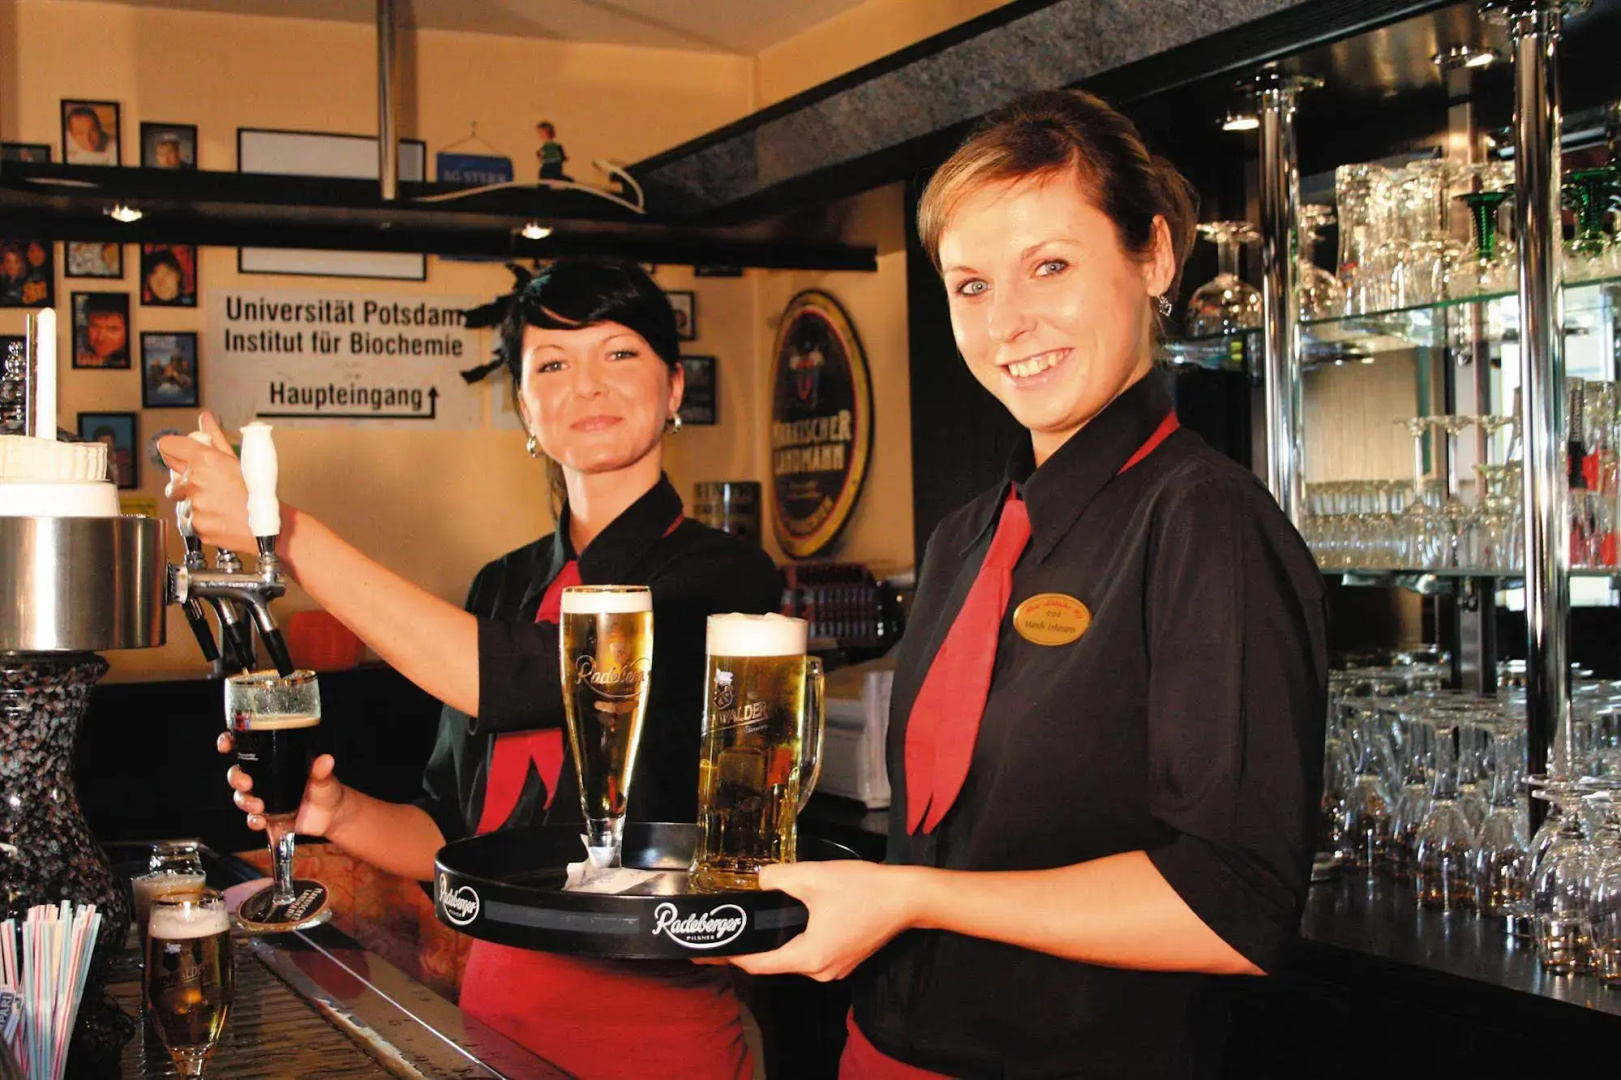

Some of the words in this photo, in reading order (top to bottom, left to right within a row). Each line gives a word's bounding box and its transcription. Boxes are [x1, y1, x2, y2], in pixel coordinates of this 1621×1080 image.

[226, 296, 355, 323] Universität
[225, 329, 303, 352] Institut
[312, 331, 341, 353] für
[350, 332, 463, 356] Biochemie
[270, 382, 422, 410] Haupteingang
[652, 902, 742, 939] Radeberger
